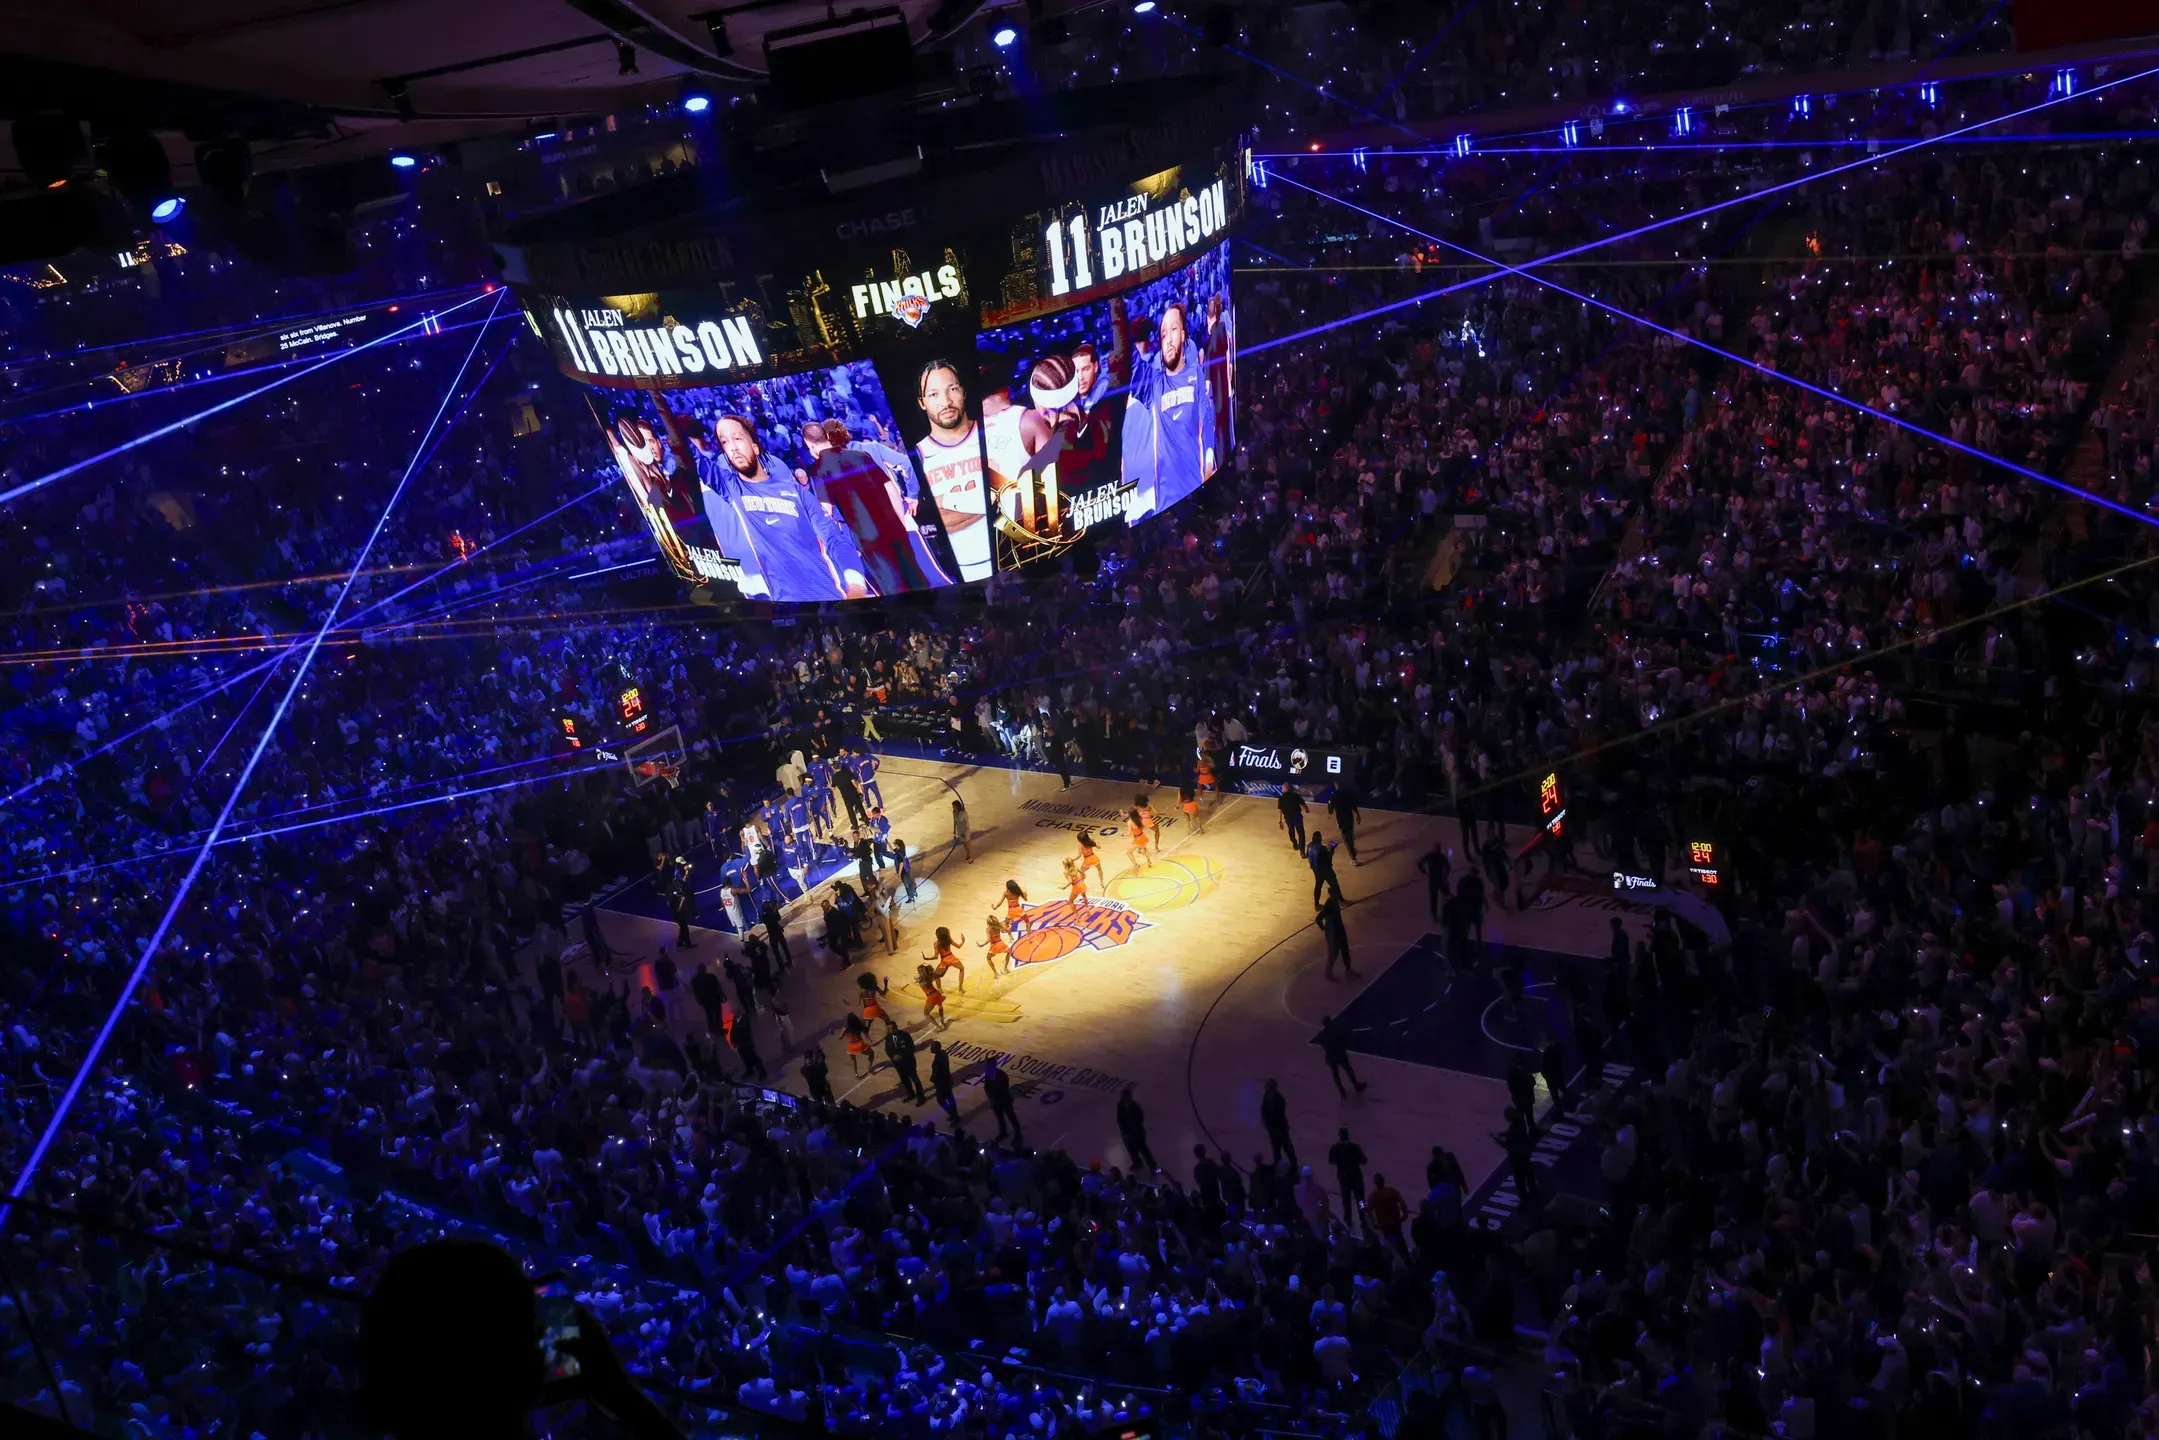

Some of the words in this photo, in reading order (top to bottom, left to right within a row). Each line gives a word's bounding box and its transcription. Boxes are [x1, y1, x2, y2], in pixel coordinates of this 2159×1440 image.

[1097, 192, 1148, 231] JALEN
[836, 208, 917, 240] CHASE
[1046, 214, 1092, 296] 11
[1101, 180, 1226, 280] BRUNSON
[851, 265, 960, 318] FINALS
[299, 328, 314, 336] from
[343, 315, 366, 325] Number
[581, 309, 624, 330] JALEN
[553, 308, 598, 374] 11
[588, 316, 762, 376] BRUNSON
[1066, 480, 1119, 518] JALEN
[1074, 487, 1140, 531] BRUNSON
[685, 545, 722, 564] JALEN
[620, 567, 660, 581] ULTRA
[622, 697, 641, 718] 24
[1240, 746, 1282, 769] Finals
[1541, 773, 1556, 793] 12:00
[1541, 785, 1558, 813] 24
[1018, 799, 1075, 816] MADISON
[1074, 805, 1121, 821] SQUARE
[1035, 819, 1101, 834] CHASE
[1691, 842, 1712, 852] 12:00
[1692, 850, 1711, 863] 24
[1629, 876, 1657, 889] Finals
[1701, 874, 1718, 884] 1:30
[1010, 1055, 1077, 1082] SQUARE
